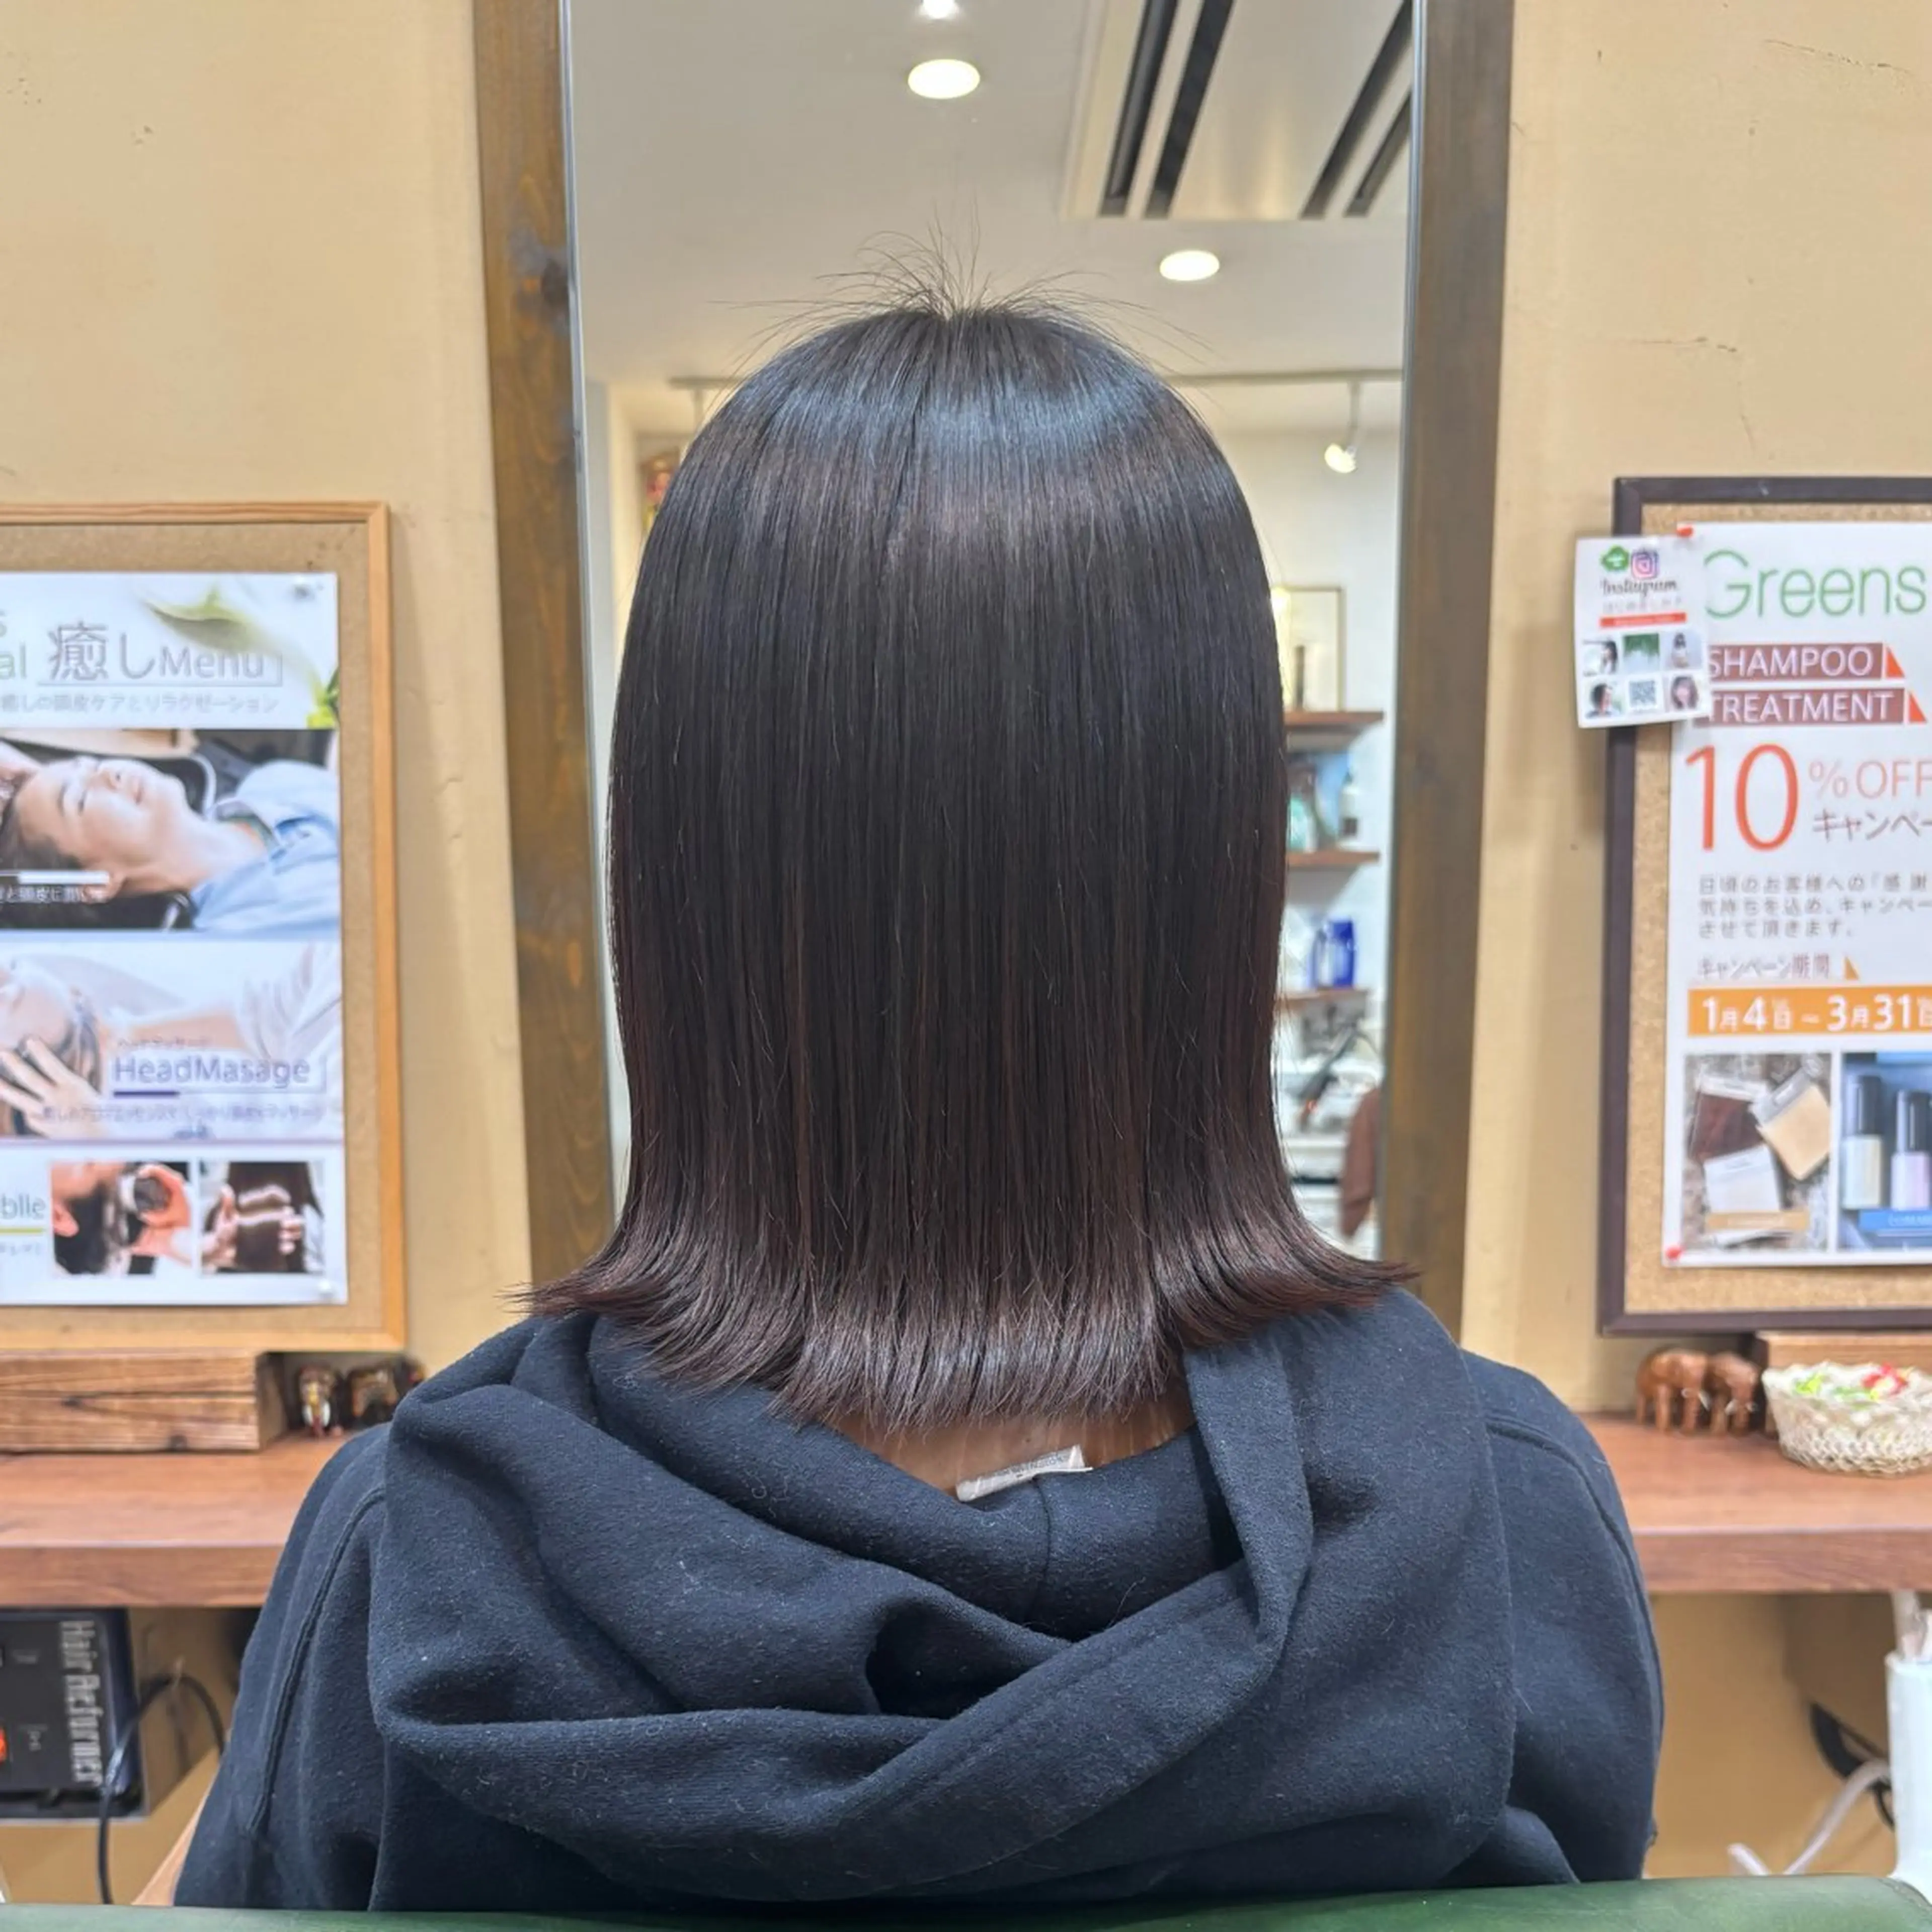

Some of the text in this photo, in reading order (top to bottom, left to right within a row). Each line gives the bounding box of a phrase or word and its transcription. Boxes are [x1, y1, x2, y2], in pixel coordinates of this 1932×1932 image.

[1704, 549, 1927, 619] Greens
[1709, 645, 1874, 678] SHAMPOO
[1709, 690, 1894, 723] TREATMENT
[1685, 743, 1799, 852] 10
[1699, 953, 1830, 979] キャンペーン期間
[115, 1057, 311, 1089] HeadMasage
